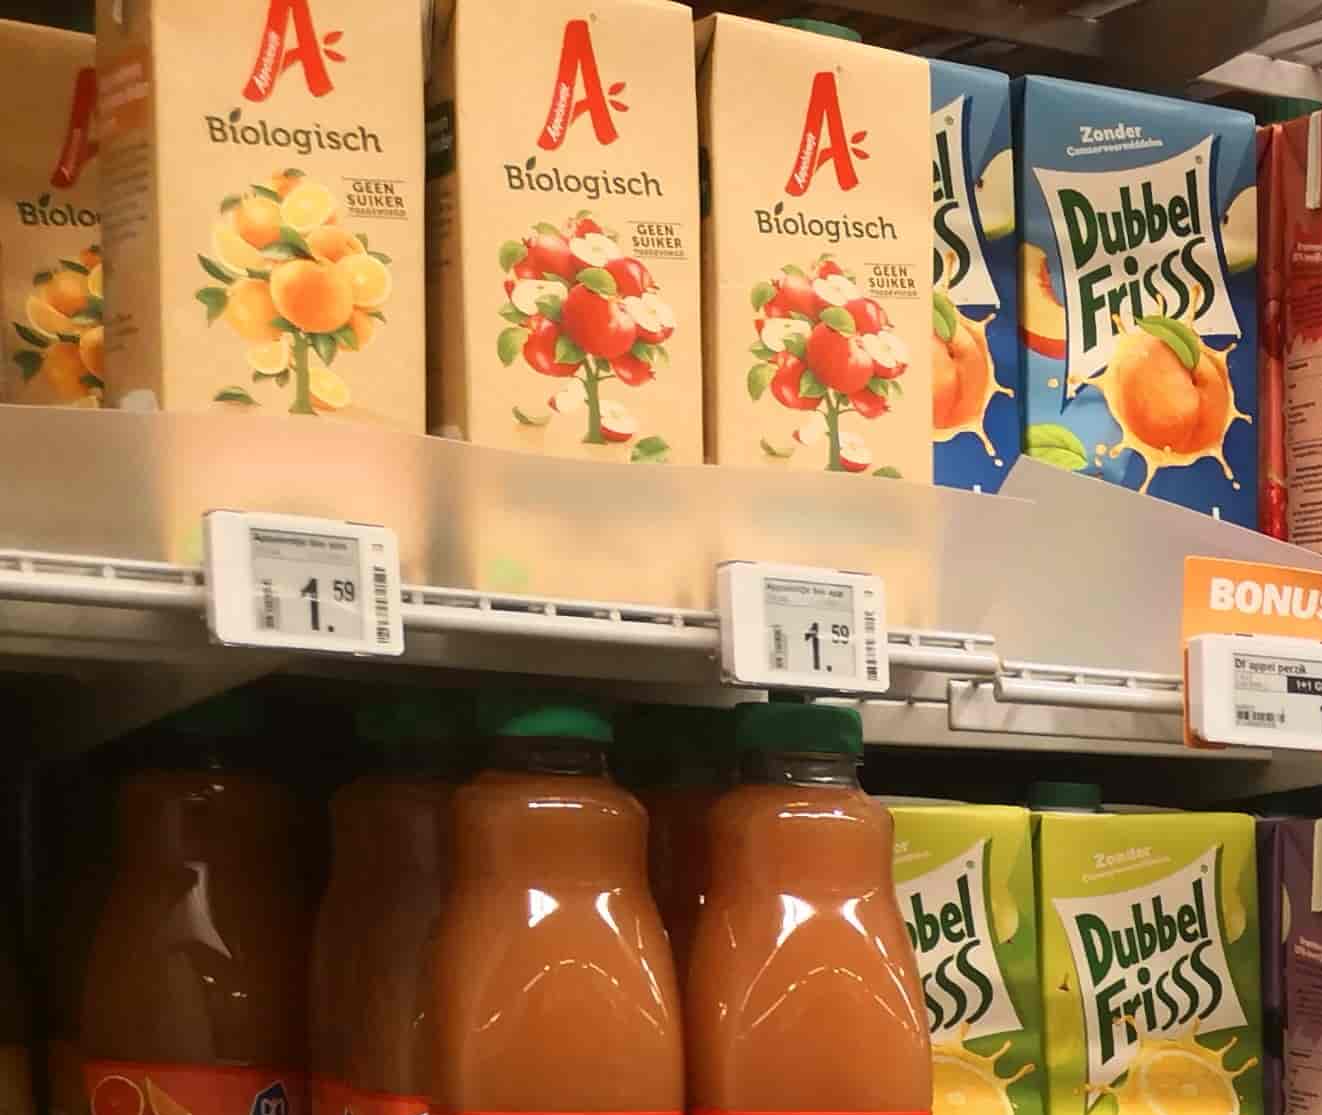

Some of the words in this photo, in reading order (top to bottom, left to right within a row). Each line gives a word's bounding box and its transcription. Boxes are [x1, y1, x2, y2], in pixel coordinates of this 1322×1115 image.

[205, 113, 382, 155] Biologisch
[1079, 124, 1144, 144] Zonder
[352, 180, 395, 195] GEEN
[504, 160, 664, 199] Biologisch
[346, 193, 405, 210] SUIKER
[754, 207, 898, 243] Biologisch
[1057, 168, 1201, 269] Dubbel
[636, 223, 674, 237] GEEN
[631, 235, 683, 250] SUIKER
[873, 265, 908, 279] GEEN
[868, 276, 915, 291] SUIKER
[1076, 878, 1208, 982] Dubbel
